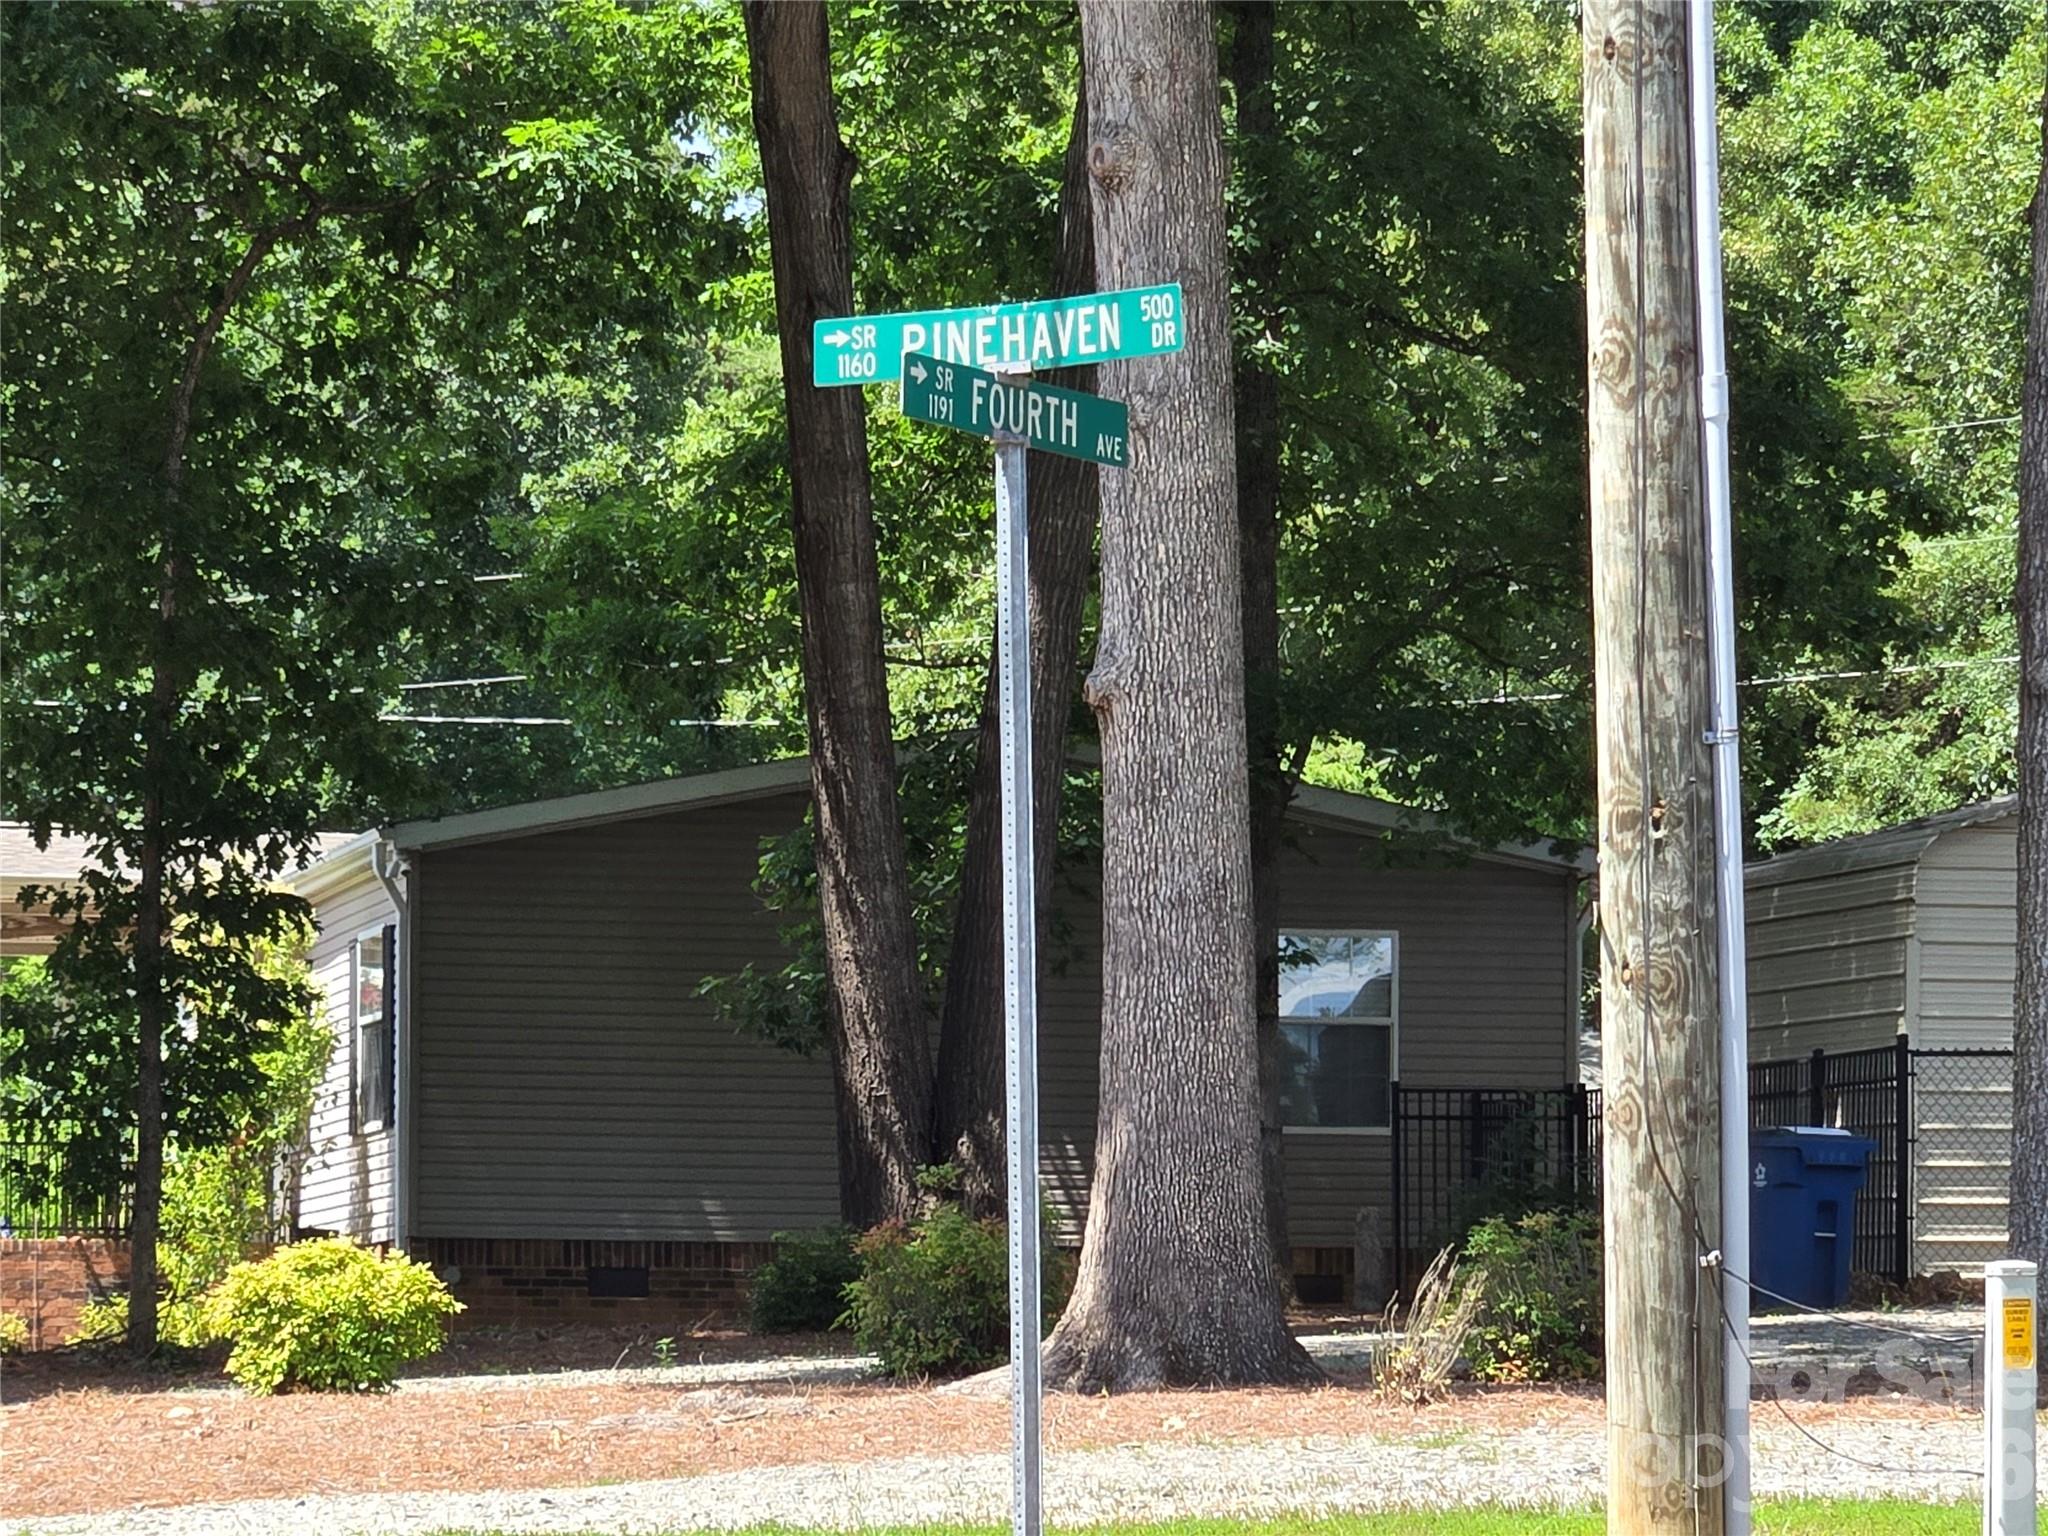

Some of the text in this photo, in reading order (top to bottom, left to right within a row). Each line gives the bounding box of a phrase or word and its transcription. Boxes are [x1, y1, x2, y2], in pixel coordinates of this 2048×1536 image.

[1140, 292, 1174, 322] 500
[851, 325, 876, 350] SR
[902, 302, 1121, 366] PINEHAVEN
[1151, 321, 1177, 348] DR
[838, 352, 877, 379] 1160
[936, 365, 954, 393] SR
[928, 393, 953, 423] 1191
[971, 378, 1077, 448] FOURTH
[1096, 433, 1122, 461] AVE
